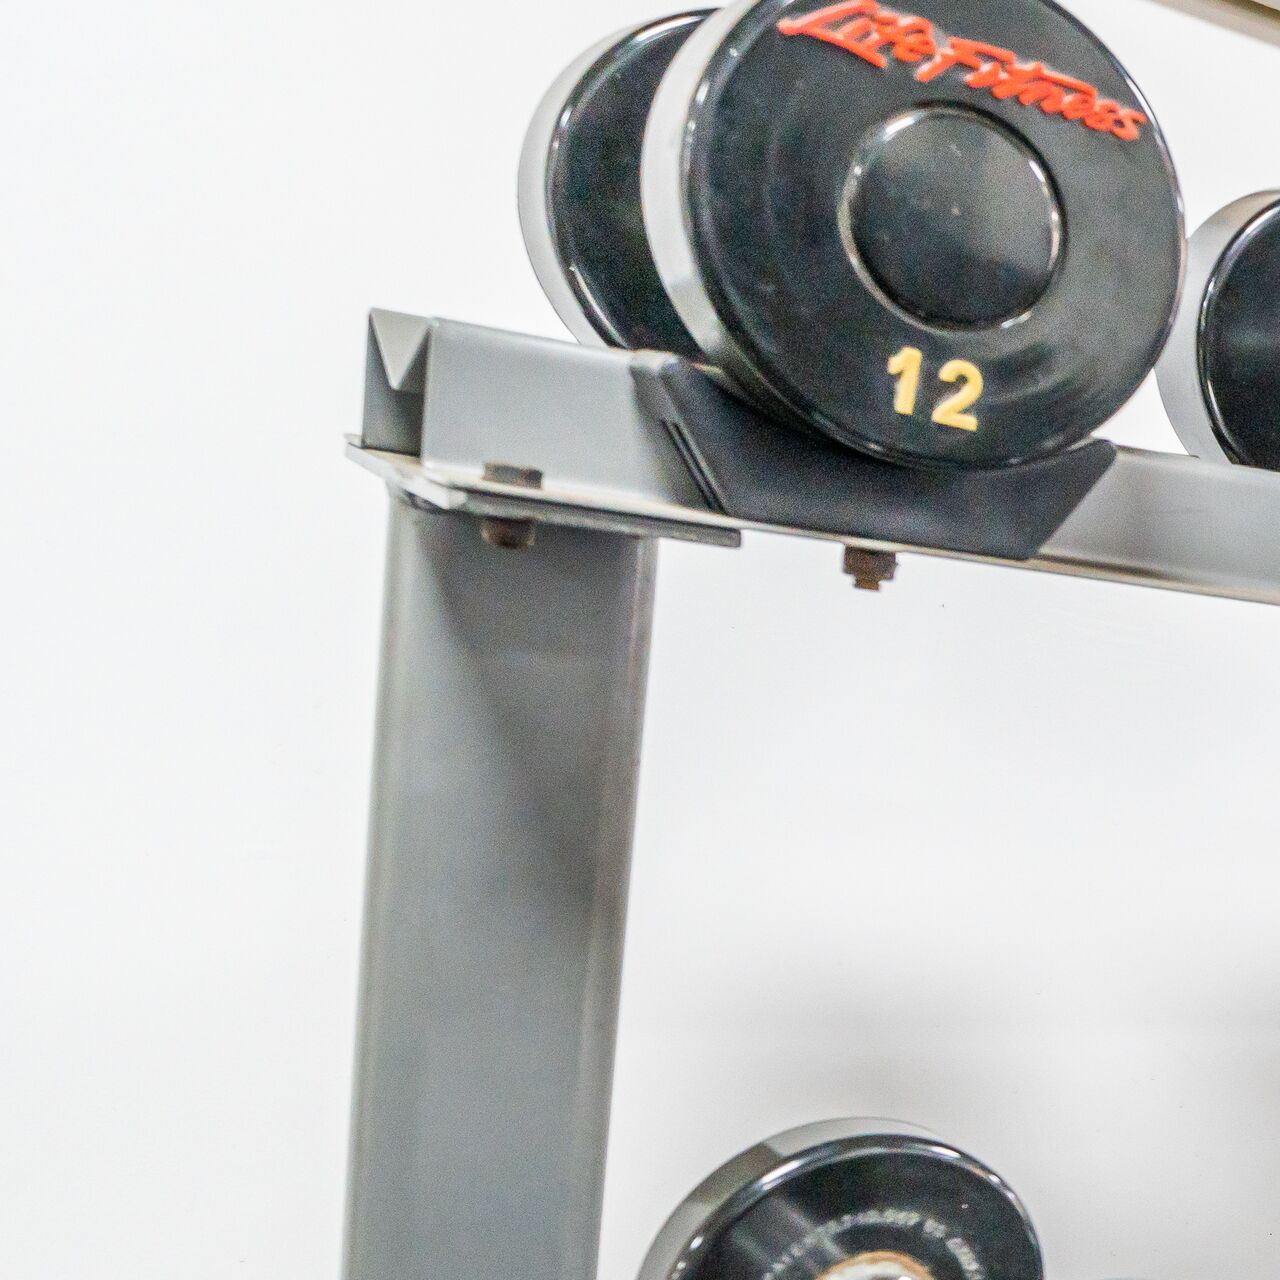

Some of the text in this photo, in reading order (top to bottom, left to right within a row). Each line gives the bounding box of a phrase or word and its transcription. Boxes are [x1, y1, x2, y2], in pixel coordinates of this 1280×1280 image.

[777, 0, 1148, 141] Life Fitness
[887, 346, 984, 432] 12
